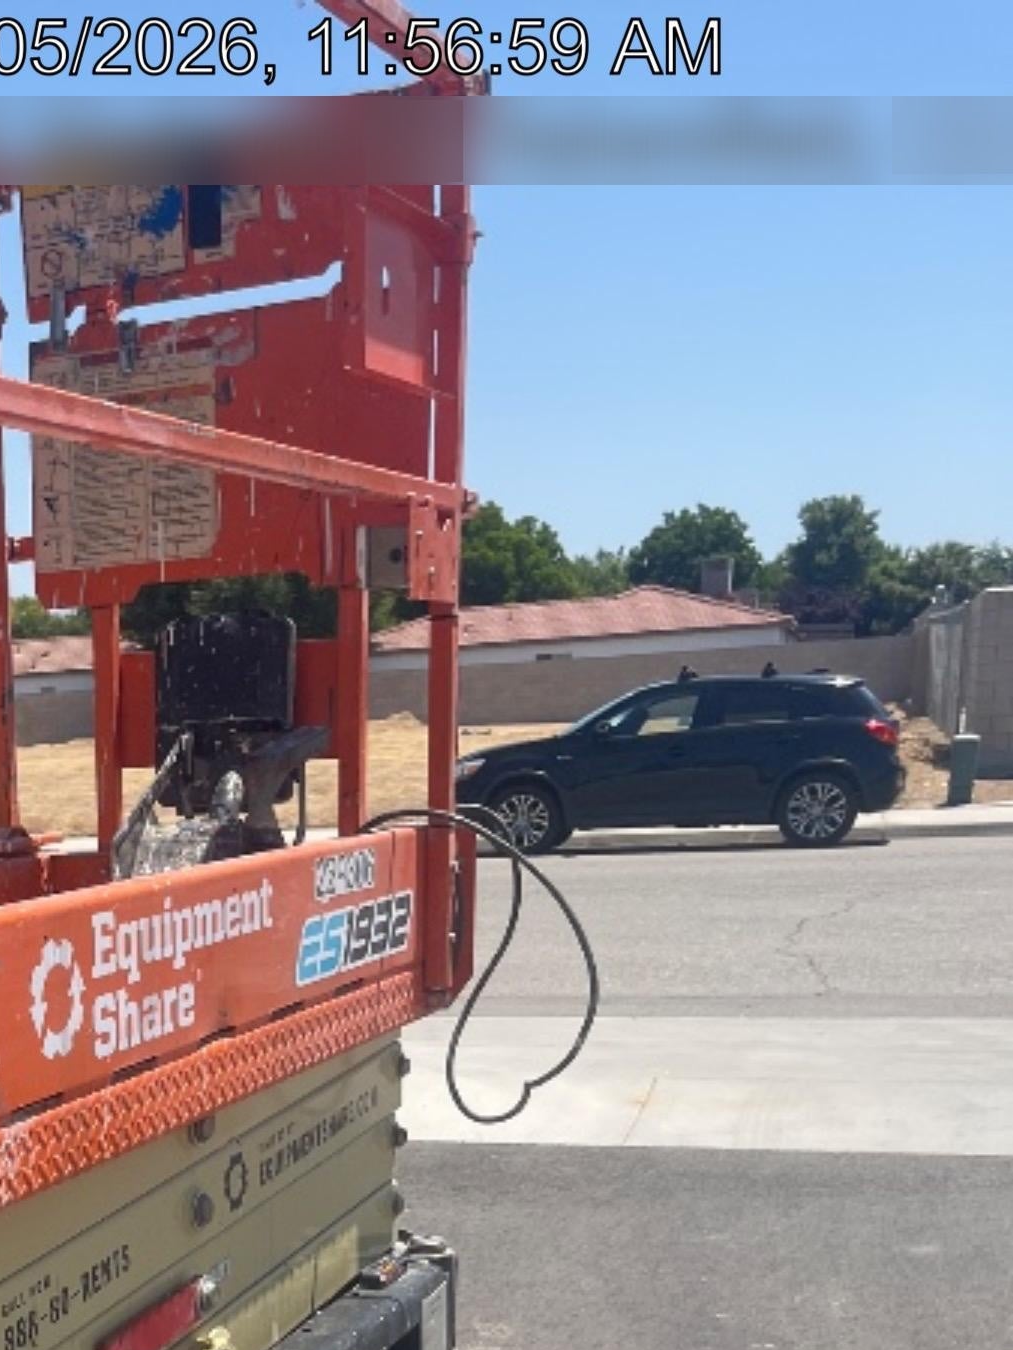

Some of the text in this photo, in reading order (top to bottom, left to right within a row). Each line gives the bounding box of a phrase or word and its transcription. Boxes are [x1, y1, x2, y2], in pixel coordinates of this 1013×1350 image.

[91, 878, 274, 984] Equipment
[296, 888, 414, 988] ES1932
[91, 981, 196, 1060] Share
